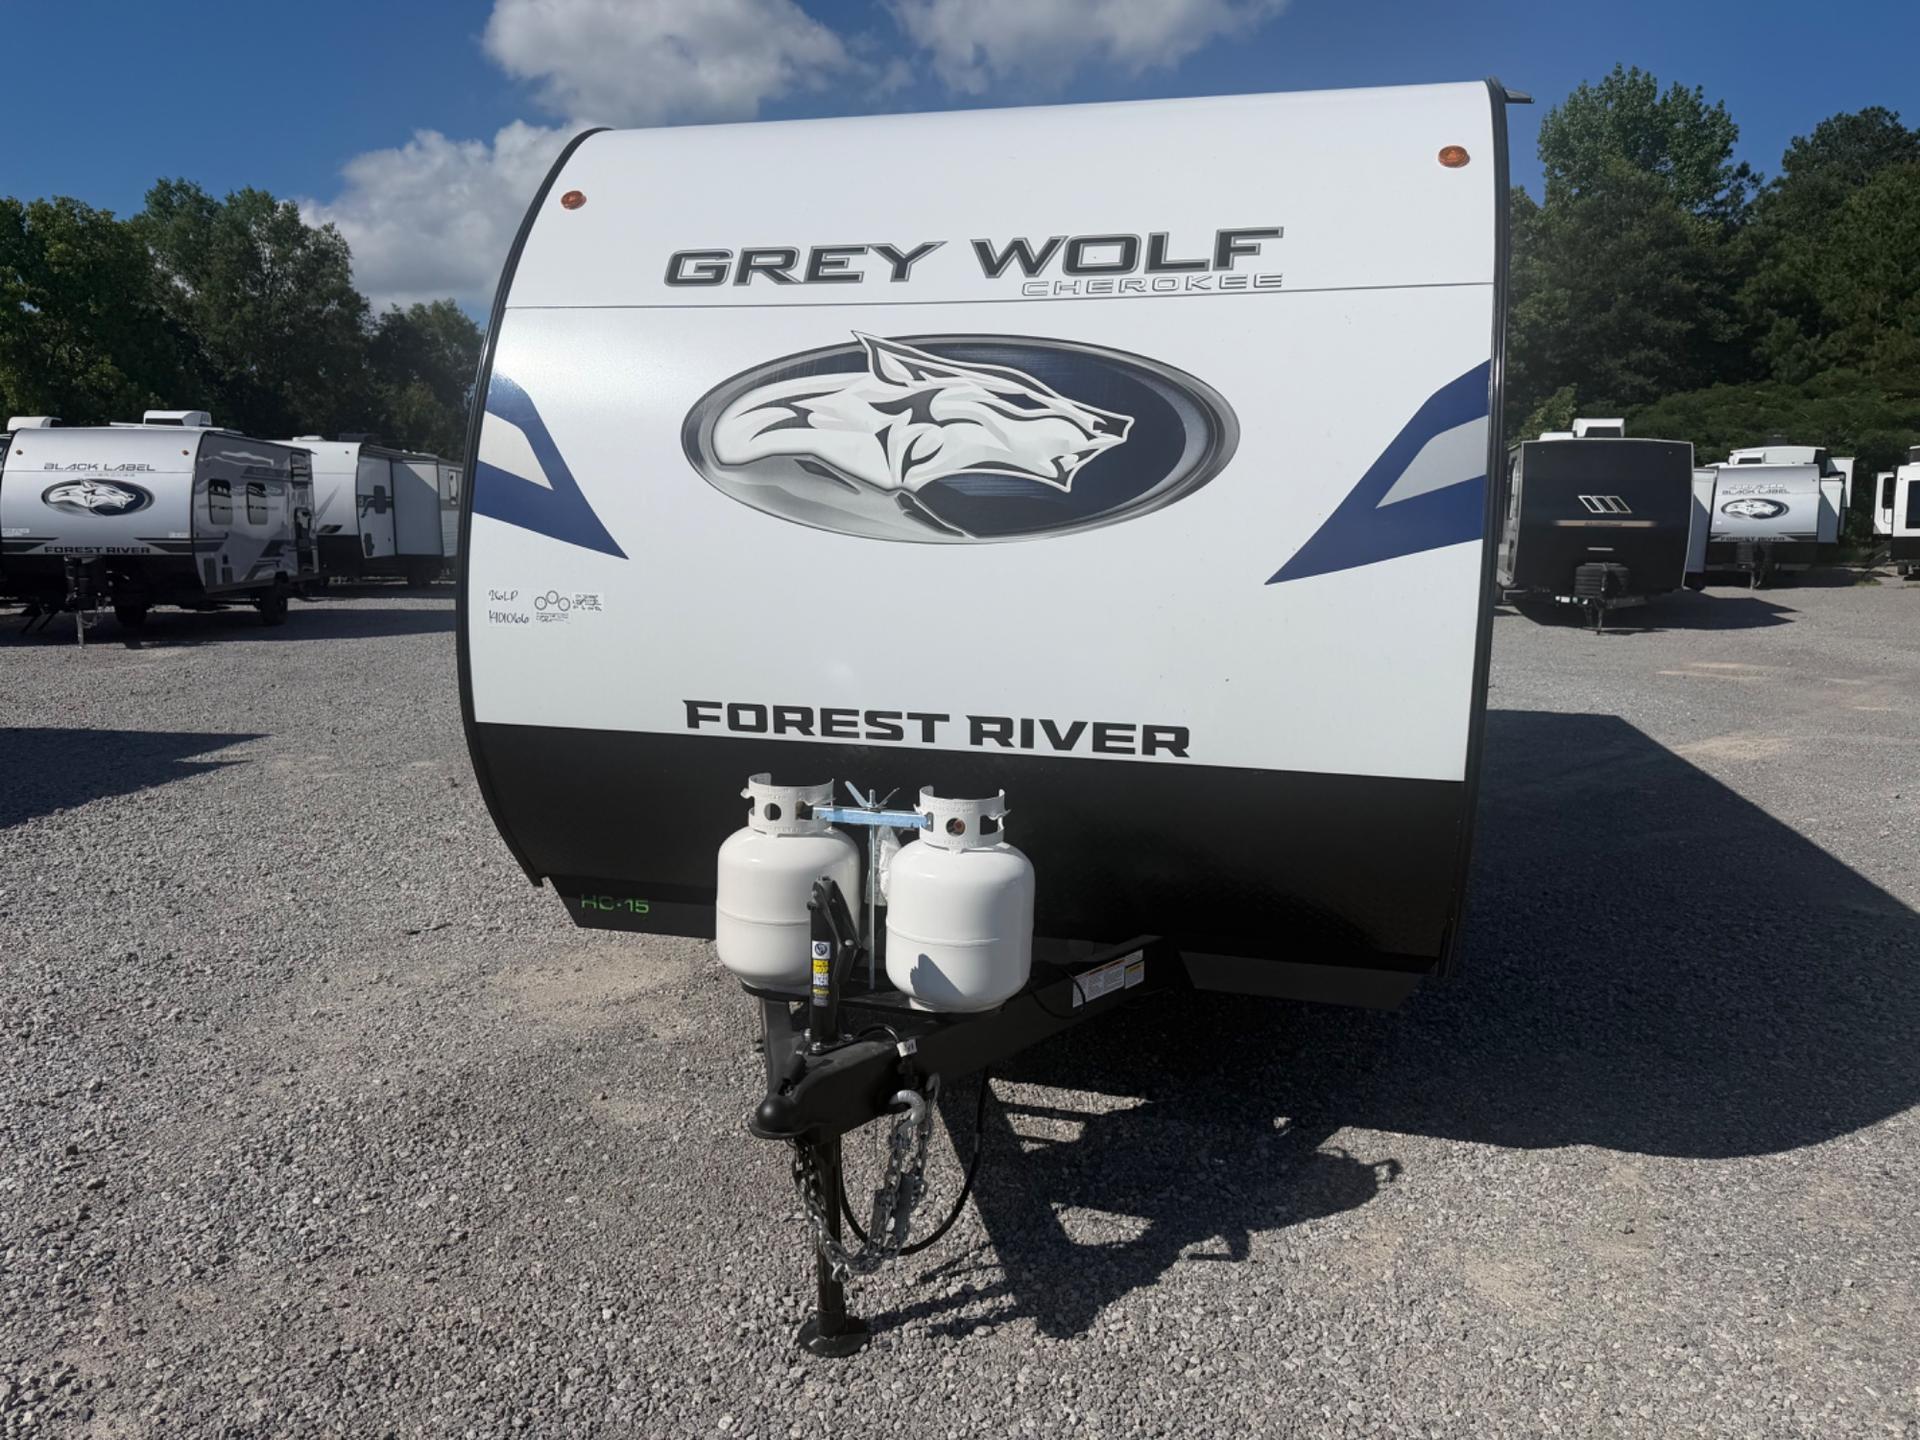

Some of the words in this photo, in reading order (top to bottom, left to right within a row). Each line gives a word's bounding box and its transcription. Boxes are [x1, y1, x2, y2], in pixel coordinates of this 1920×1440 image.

[664, 239, 948, 287] GREY
[970, 226, 1285, 279] WOLF
[1021, 273, 1284, 297] CHEROKEE
[43, 462, 100, 472] BLACK
[103, 463, 156, 472] LABEL
[44, 546, 103, 554] FOREST
[105, 546, 151, 554] RIVER
[682, 699, 950, 744] FOREST
[965, 715, 1191, 758] RIVER
